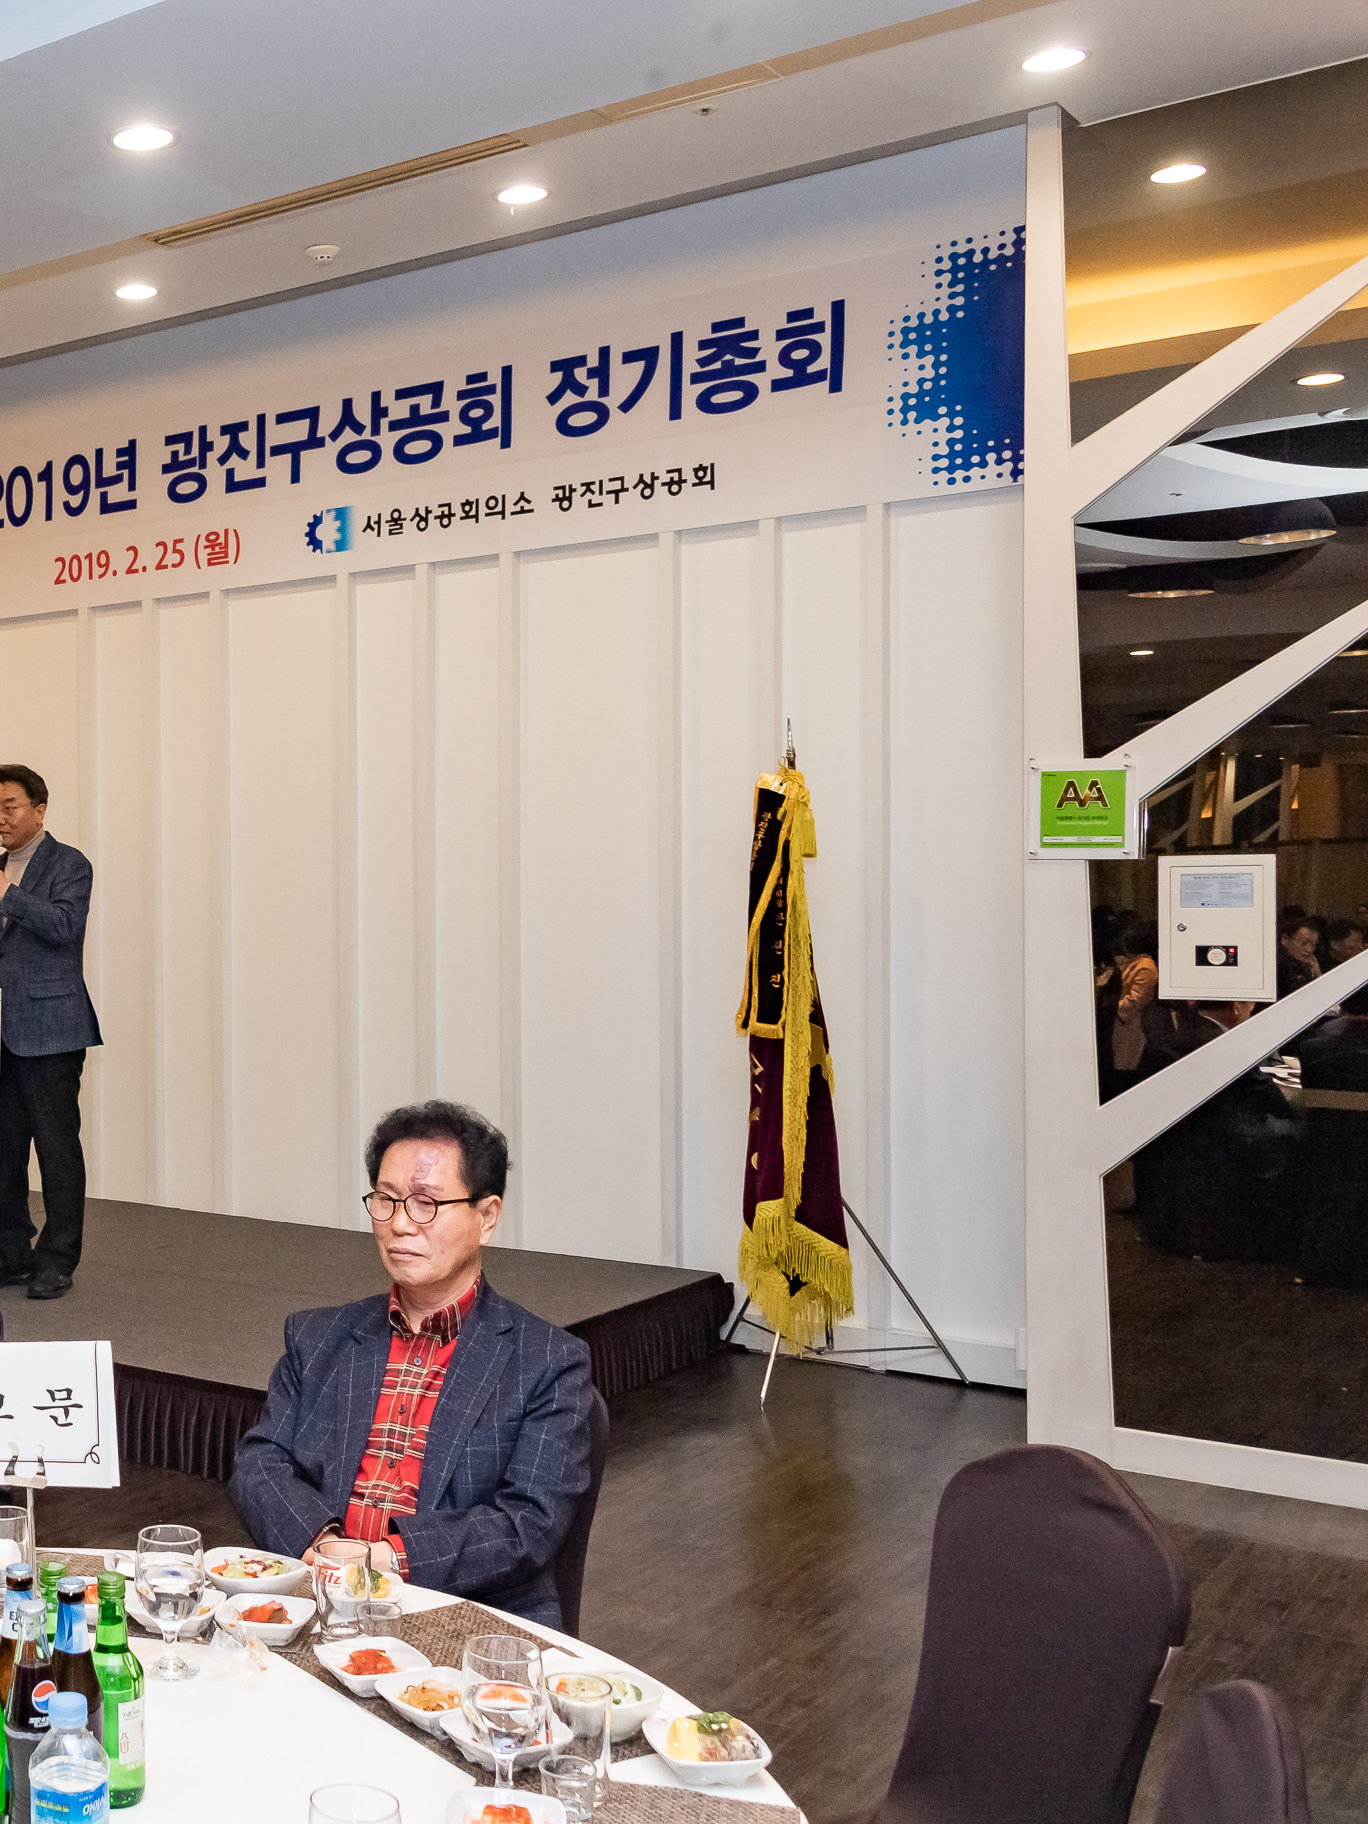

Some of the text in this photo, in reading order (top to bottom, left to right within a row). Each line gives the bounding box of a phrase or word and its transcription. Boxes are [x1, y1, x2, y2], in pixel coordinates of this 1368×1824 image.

[162, 365, 513, 505] 광진구상공회
[546, 299, 845, 437] 정기총회
[362, 462, 715, 538] 서울상공회의소 광진구상공회
[53, 550, 118, 585] 2019.
[1054, 779, 1110, 809] AA
[317, 1564, 341, 1585] Fitz
